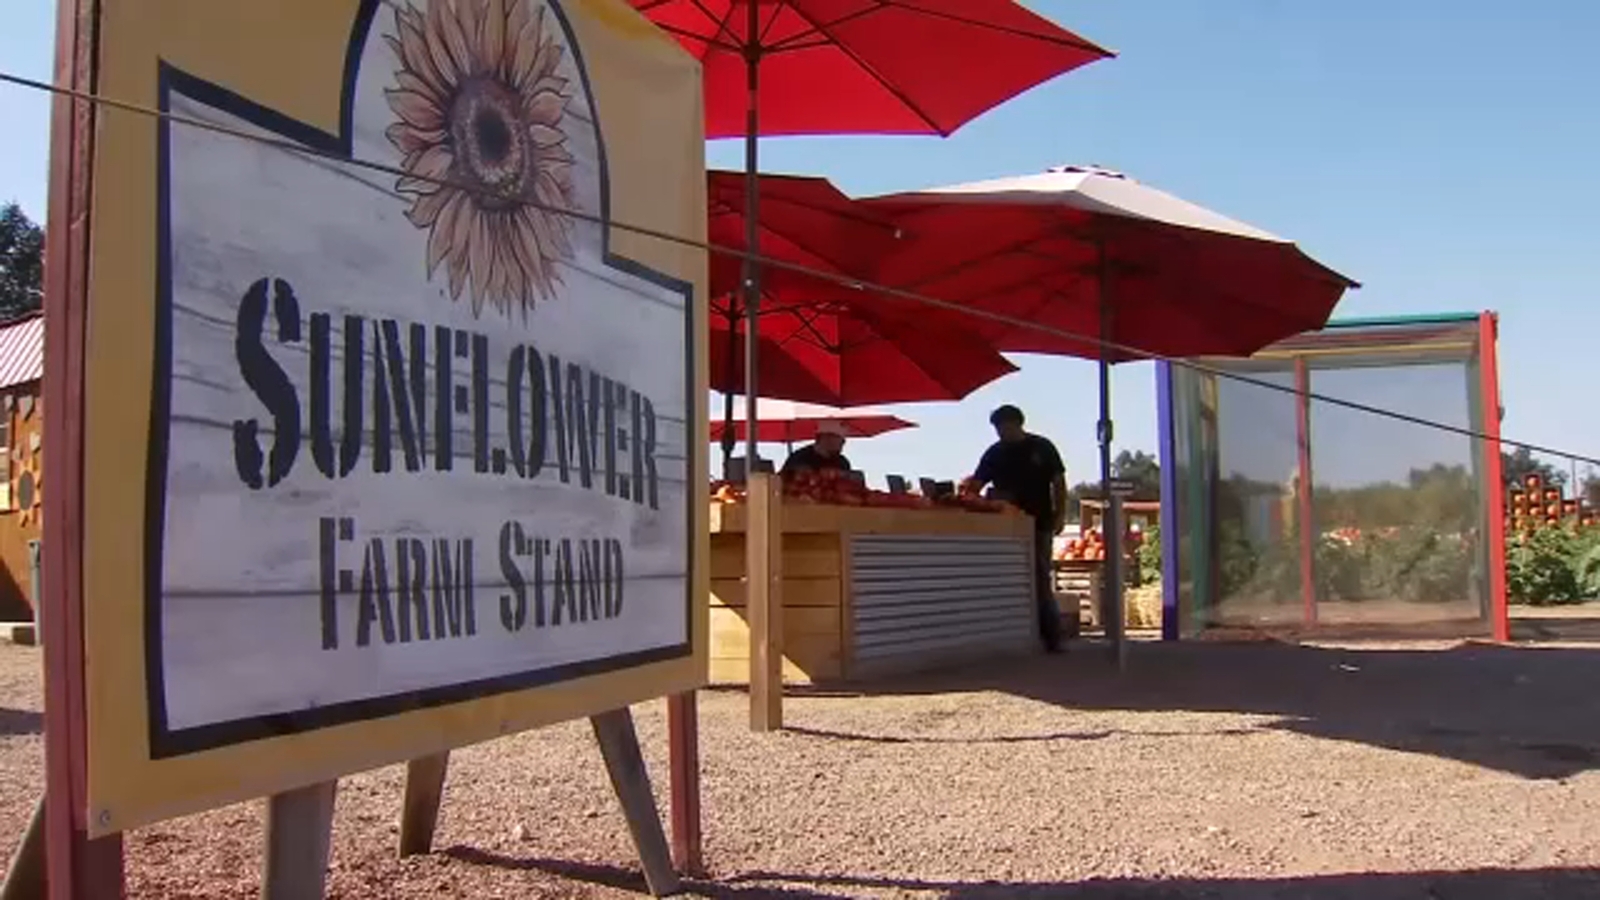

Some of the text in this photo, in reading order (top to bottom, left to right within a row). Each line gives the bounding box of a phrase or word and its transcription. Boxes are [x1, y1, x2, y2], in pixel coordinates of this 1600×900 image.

[233, 276, 659, 510] SUNFLOWER
[319, 516, 624, 650] FARM STAND
